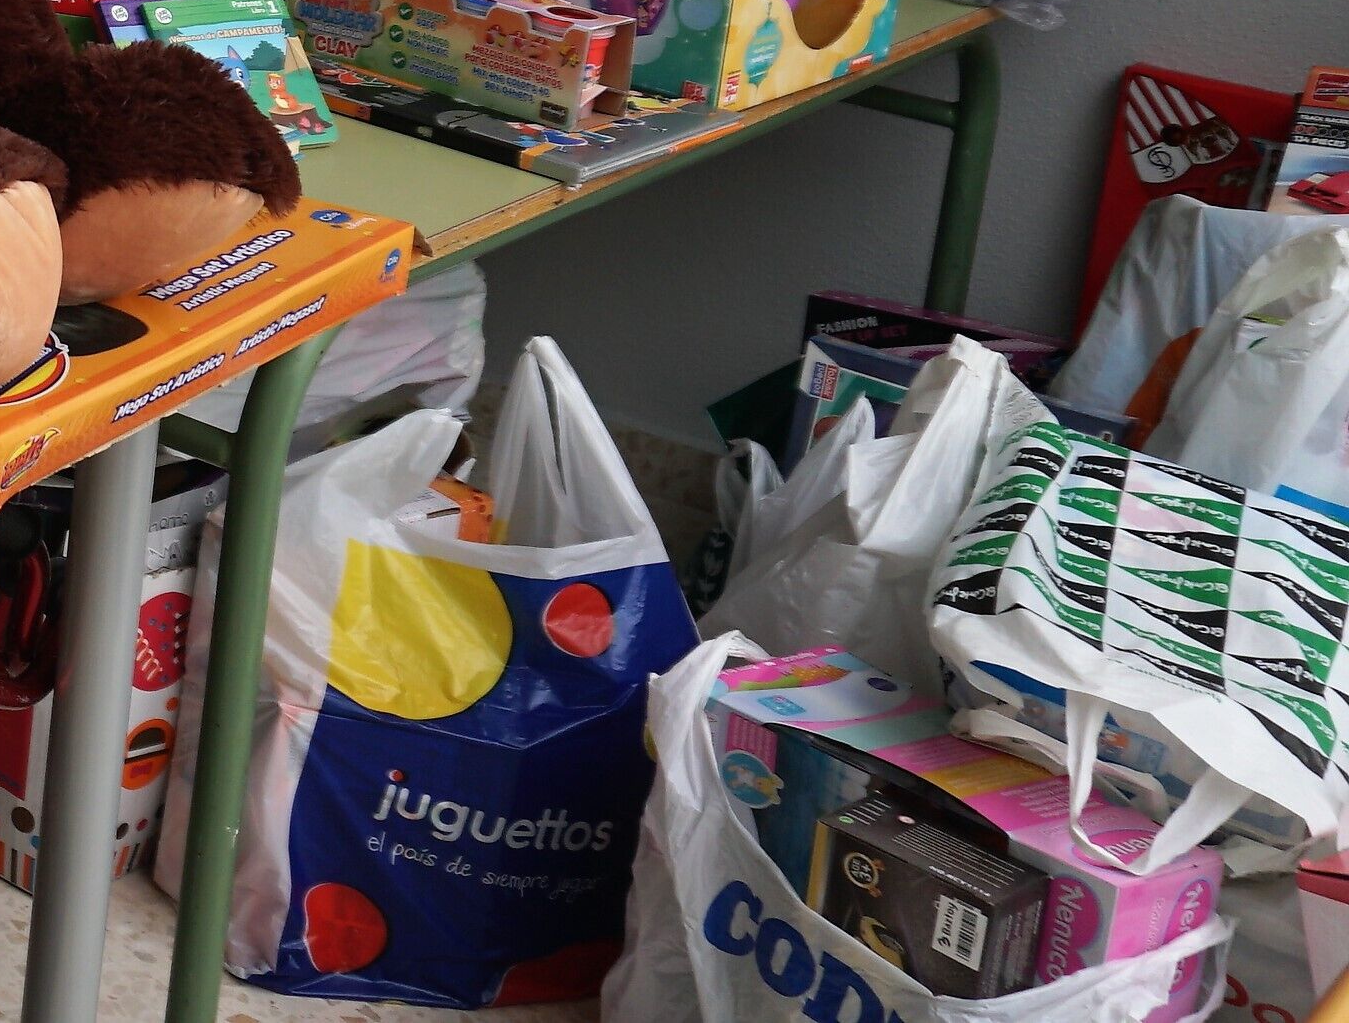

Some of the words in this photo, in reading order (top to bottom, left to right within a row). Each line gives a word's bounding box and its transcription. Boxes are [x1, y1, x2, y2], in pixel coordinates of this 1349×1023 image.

[216, 24, 284, 39] CAMPAMENTO!
[314, 34, 361, 60] CLAY
[146, 272, 195, 303] Mega
[193, 254, 226, 282] Set
[224, 227, 295, 269] Artístico
[181, 285, 226, 314] Artistic
[224, 261, 278, 296] Megaset
[816, 315, 879, 334] FASHION
[112, 396, 150, 424] Mega
[147, 382, 176, 406] Set
[172, 351, 228, 395] Artístico
[235, 321, 275, 357] Artistic
[272, 293, 328, 337] Megaset
[373, 770, 614, 854] juguettos
[367, 834, 385, 854] el
[389, 839, 437, 871] país
[444, 854, 472, 879] de
[481, 867, 550, 895] siempre
[1043, 884, 1085, 984] Nenuco
